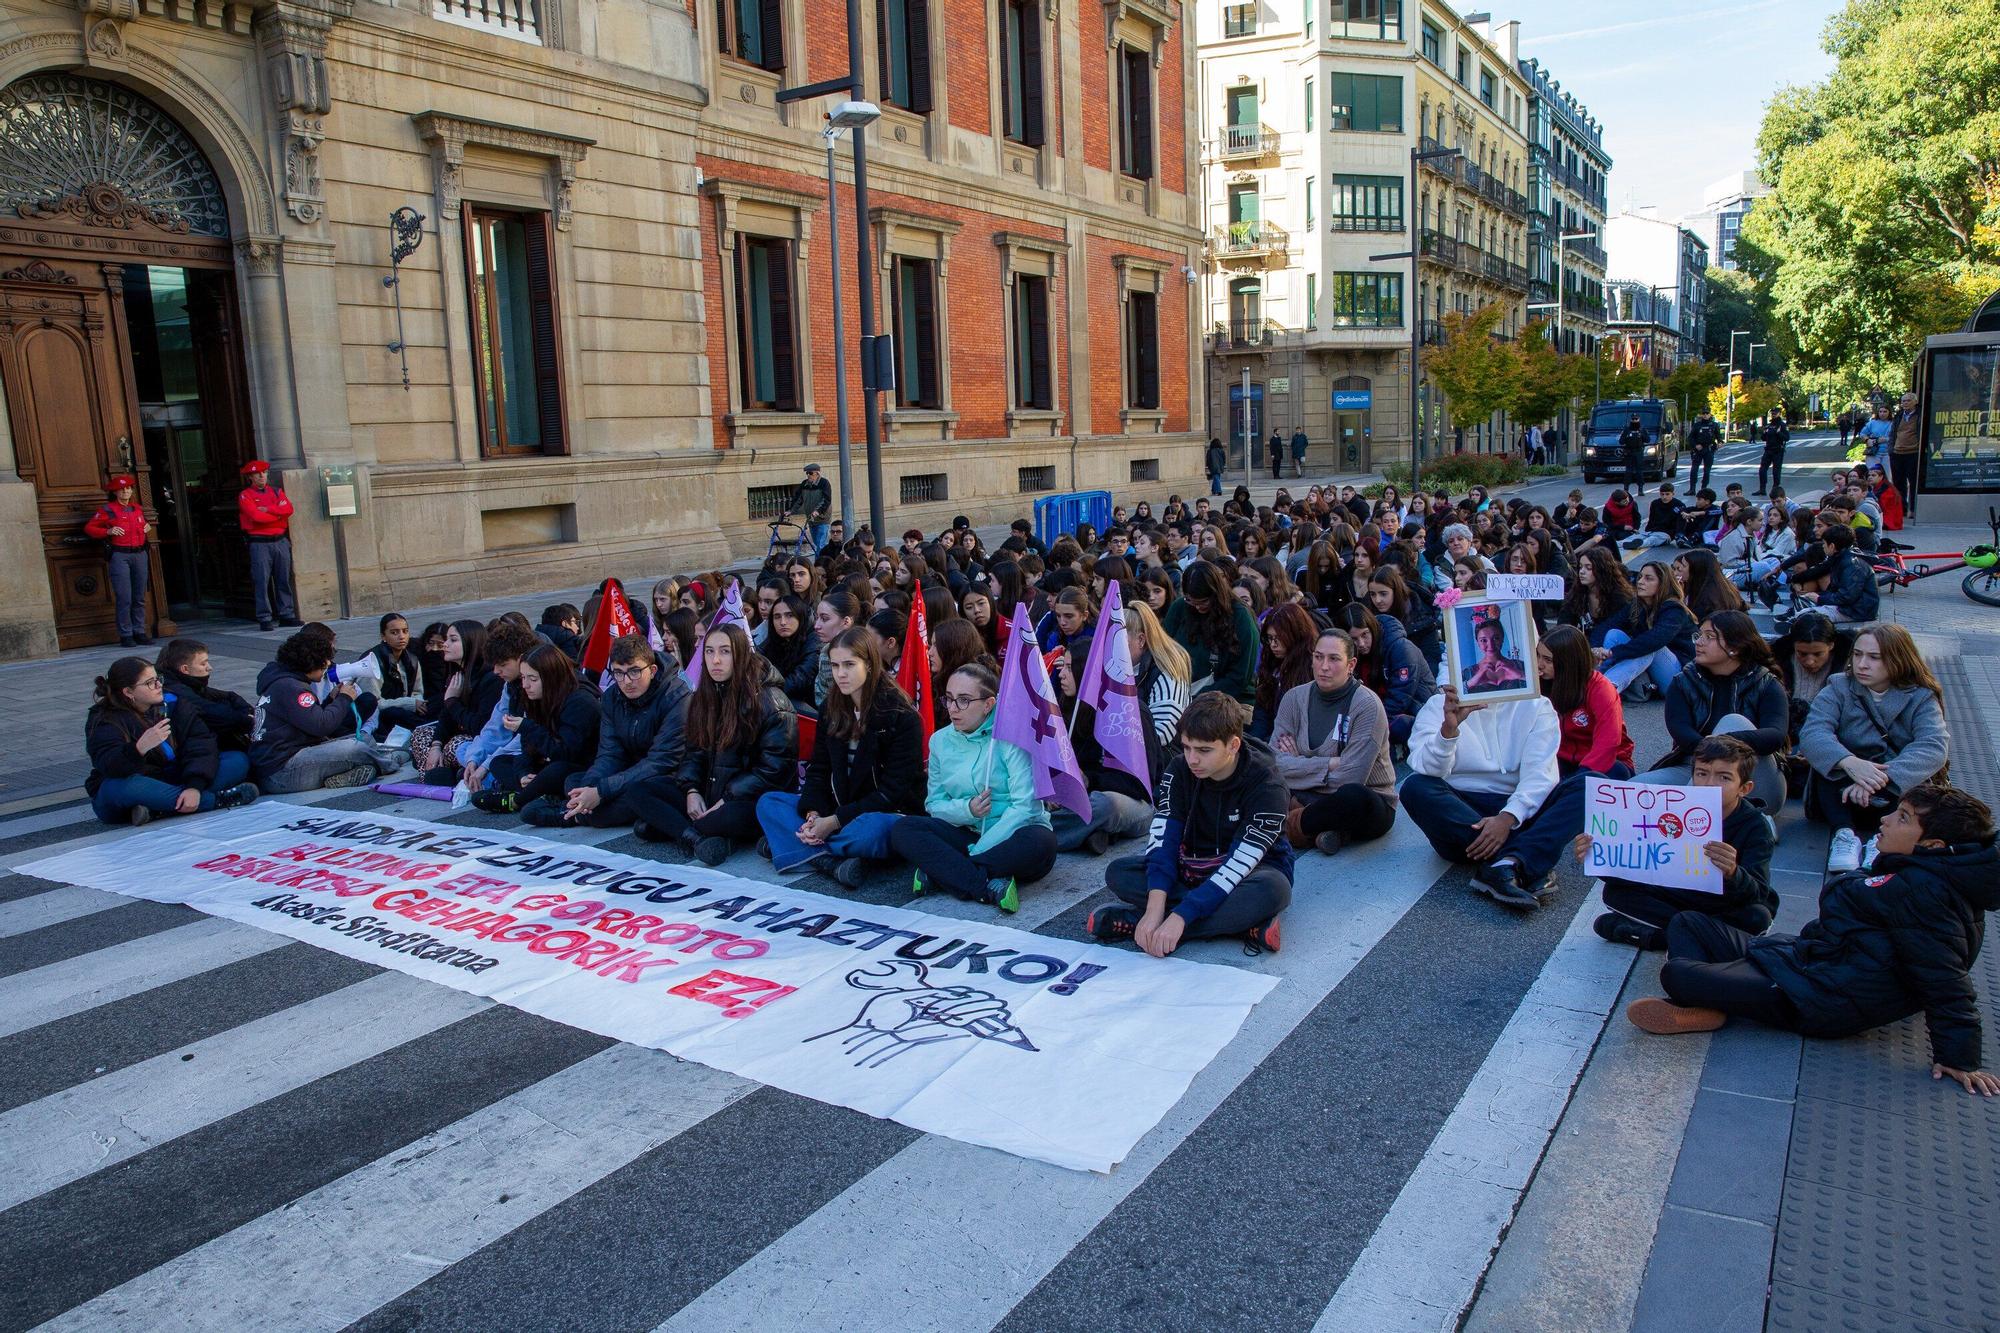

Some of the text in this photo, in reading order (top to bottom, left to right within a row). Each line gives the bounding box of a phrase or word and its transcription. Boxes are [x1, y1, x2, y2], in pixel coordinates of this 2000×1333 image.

[1935, 411, 1949, 424] UN
[1488, 576, 1559, 589] NO ME OLVIDEN
[1516, 588, 1542, 599] NUNCA
[1595, 784, 1686, 811] STOP
[250, 893, 500, 976] Ikasle Sindikatua
[279, 817, 1108, 997] SANDRA EZ ZAITUGU AHAZTUKO!
[434, 872, 523, 905] ETA
[511, 893, 771, 961] GORROTO
[191, 853, 800, 1020] DISKURTSO GEHIAGORIK EZ!
